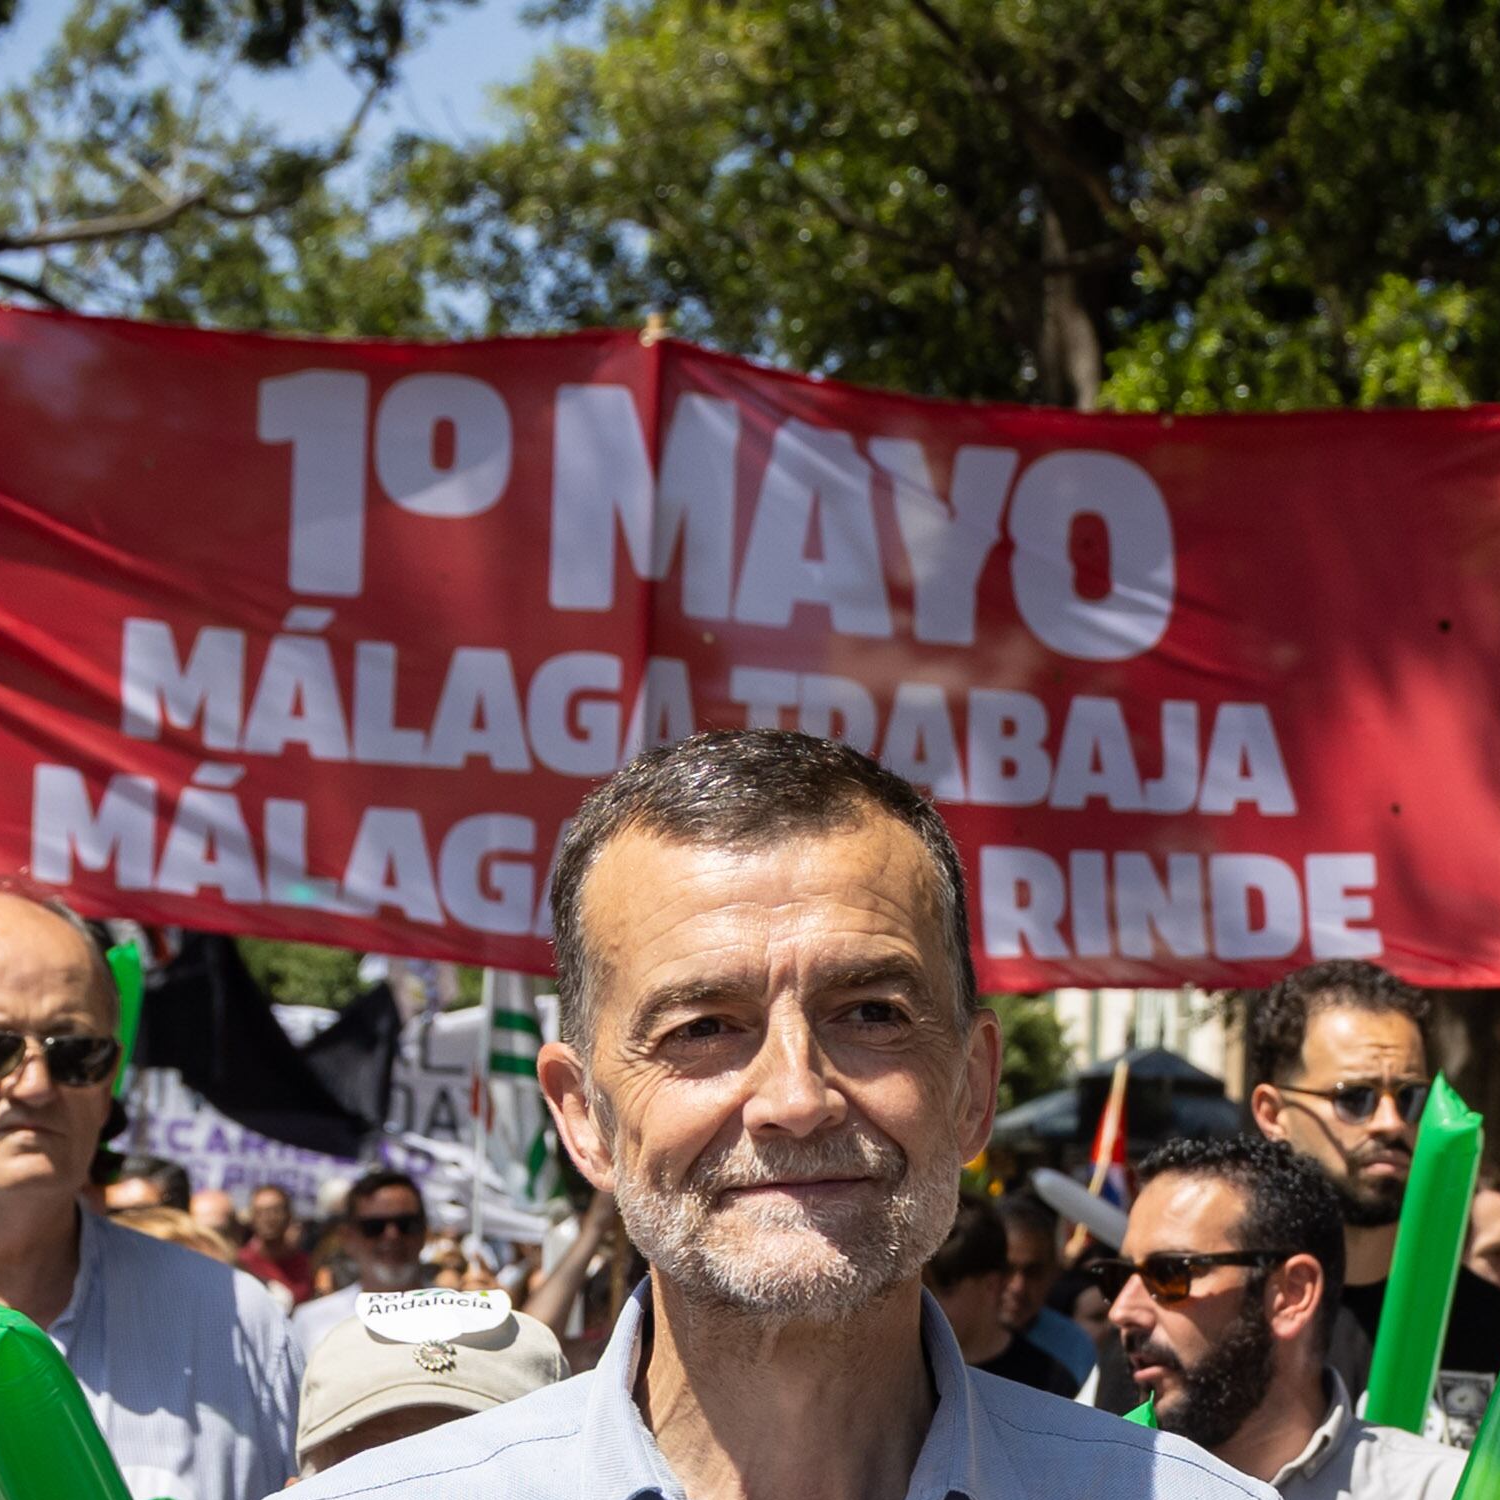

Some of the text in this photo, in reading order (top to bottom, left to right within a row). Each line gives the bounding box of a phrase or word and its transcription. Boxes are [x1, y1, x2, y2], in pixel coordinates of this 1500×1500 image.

[548, 383, 1177, 661] MAYO
[120, 606, 697, 777] MÁLAGA
[979, 845, 1385, 961] RINDE
